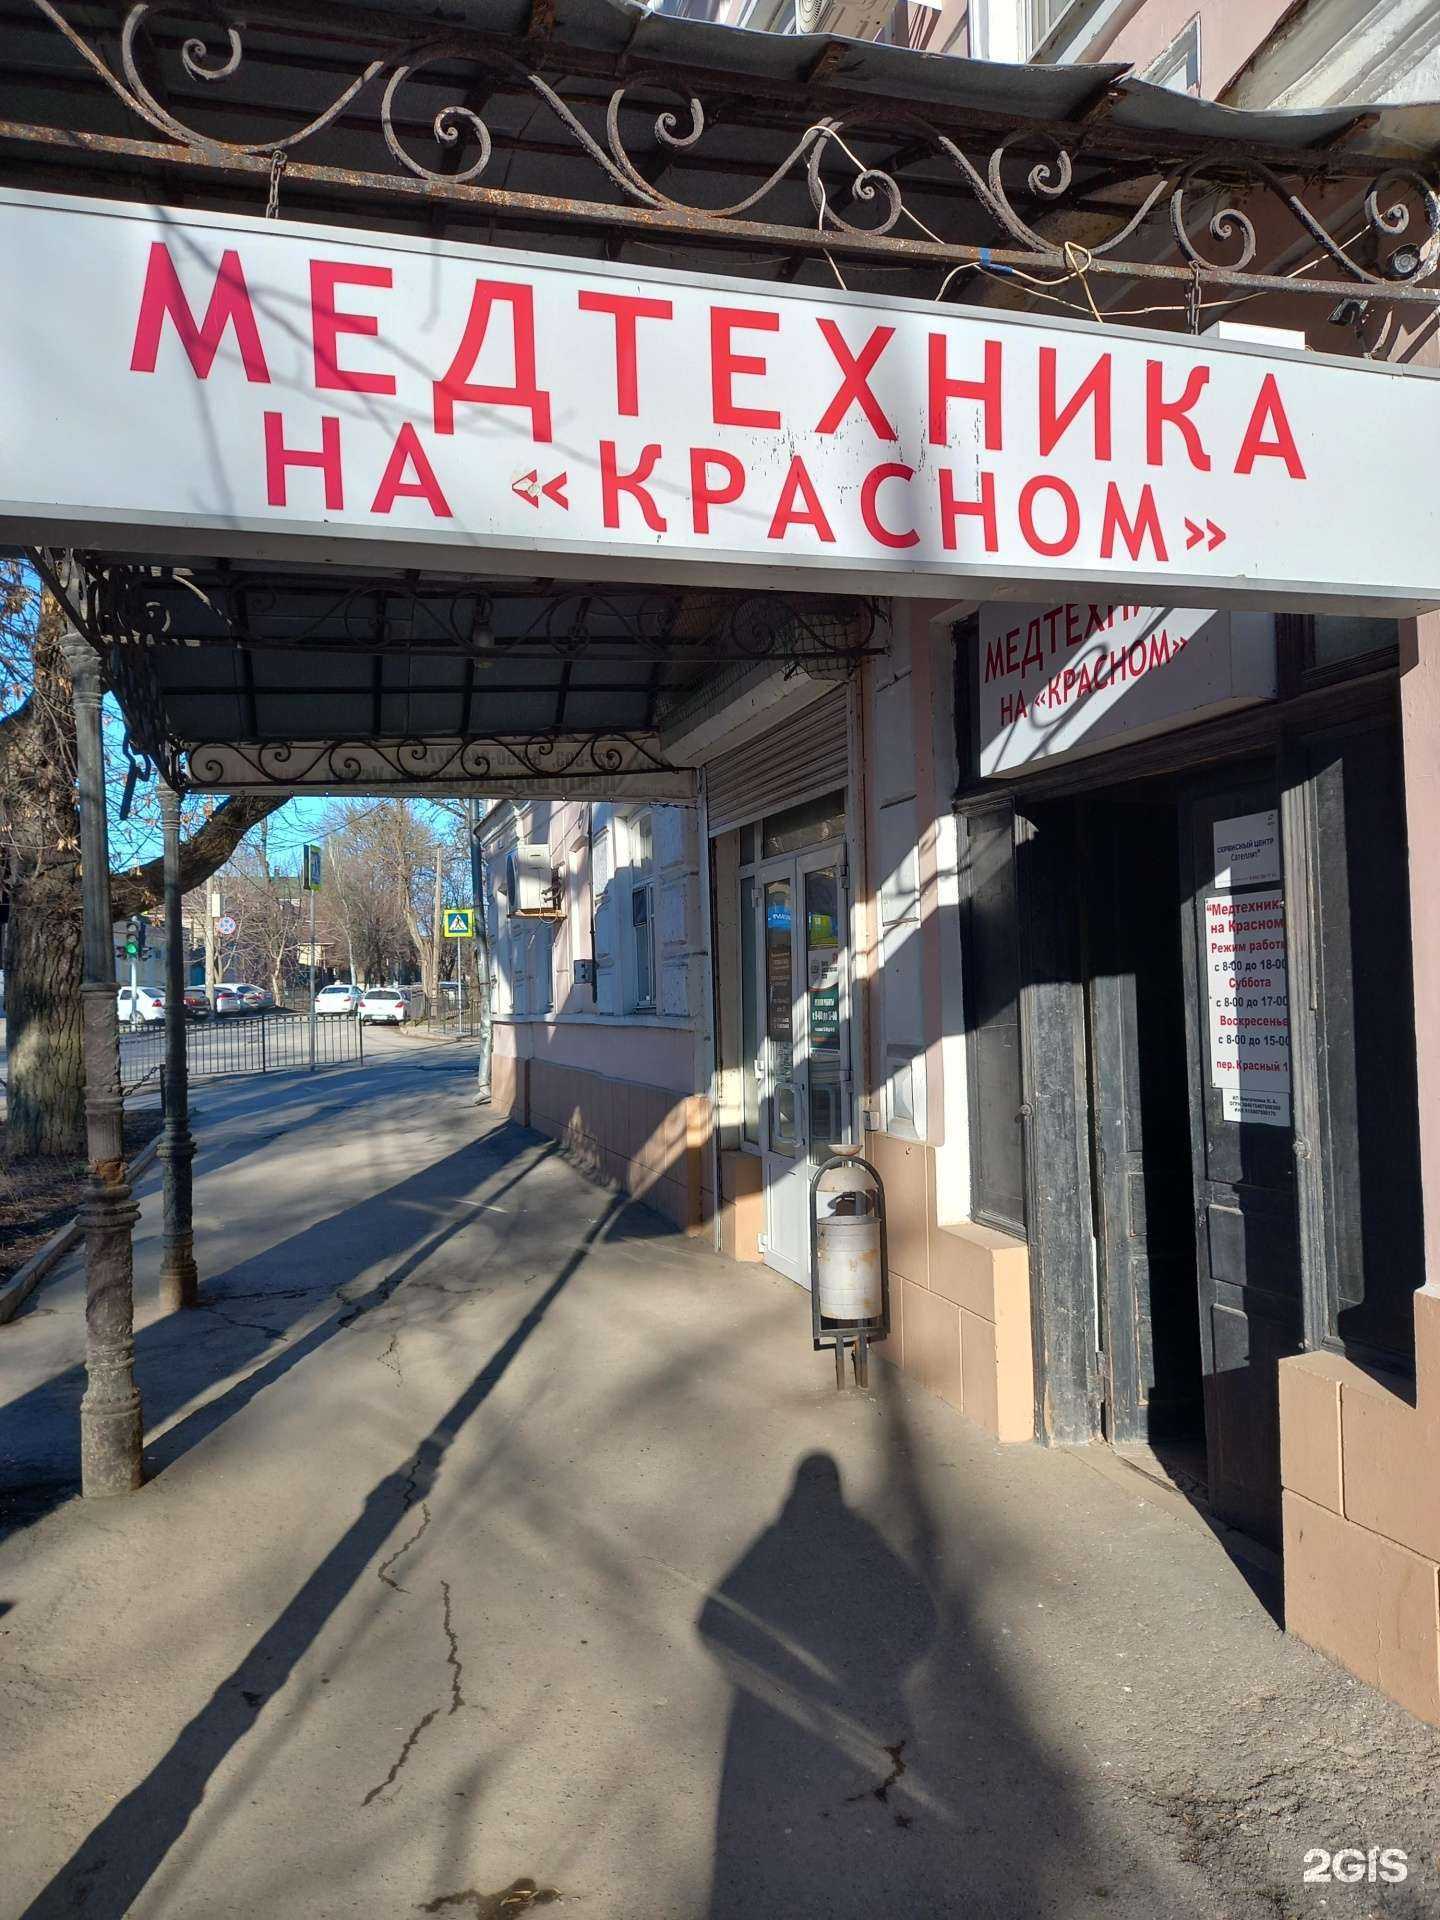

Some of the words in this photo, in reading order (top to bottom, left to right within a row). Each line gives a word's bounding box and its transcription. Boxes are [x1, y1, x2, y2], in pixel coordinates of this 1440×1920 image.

[130, 241, 1307, 480] МЕДТЕХНИКА
[263, 410, 454, 518] НА
[1000, 688, 1029, 727] НА
[1034, 628, 1189, 710] «КРАСНОМ»
[1211, 923, 1225, 934] на
[1211, 942, 1247, 954] Режим
[1222, 960, 1242, 971] 8-00
[1245, 962, 1257, 972] до
[1228, 977, 1272, 990] Суббота
[1224, 997, 1243, 1008] 8-00
[1246, 998, 1258, 1009] до
[1226, 1034, 1246, 1045] 8-00
[1248, 1036, 1261, 1047] до
